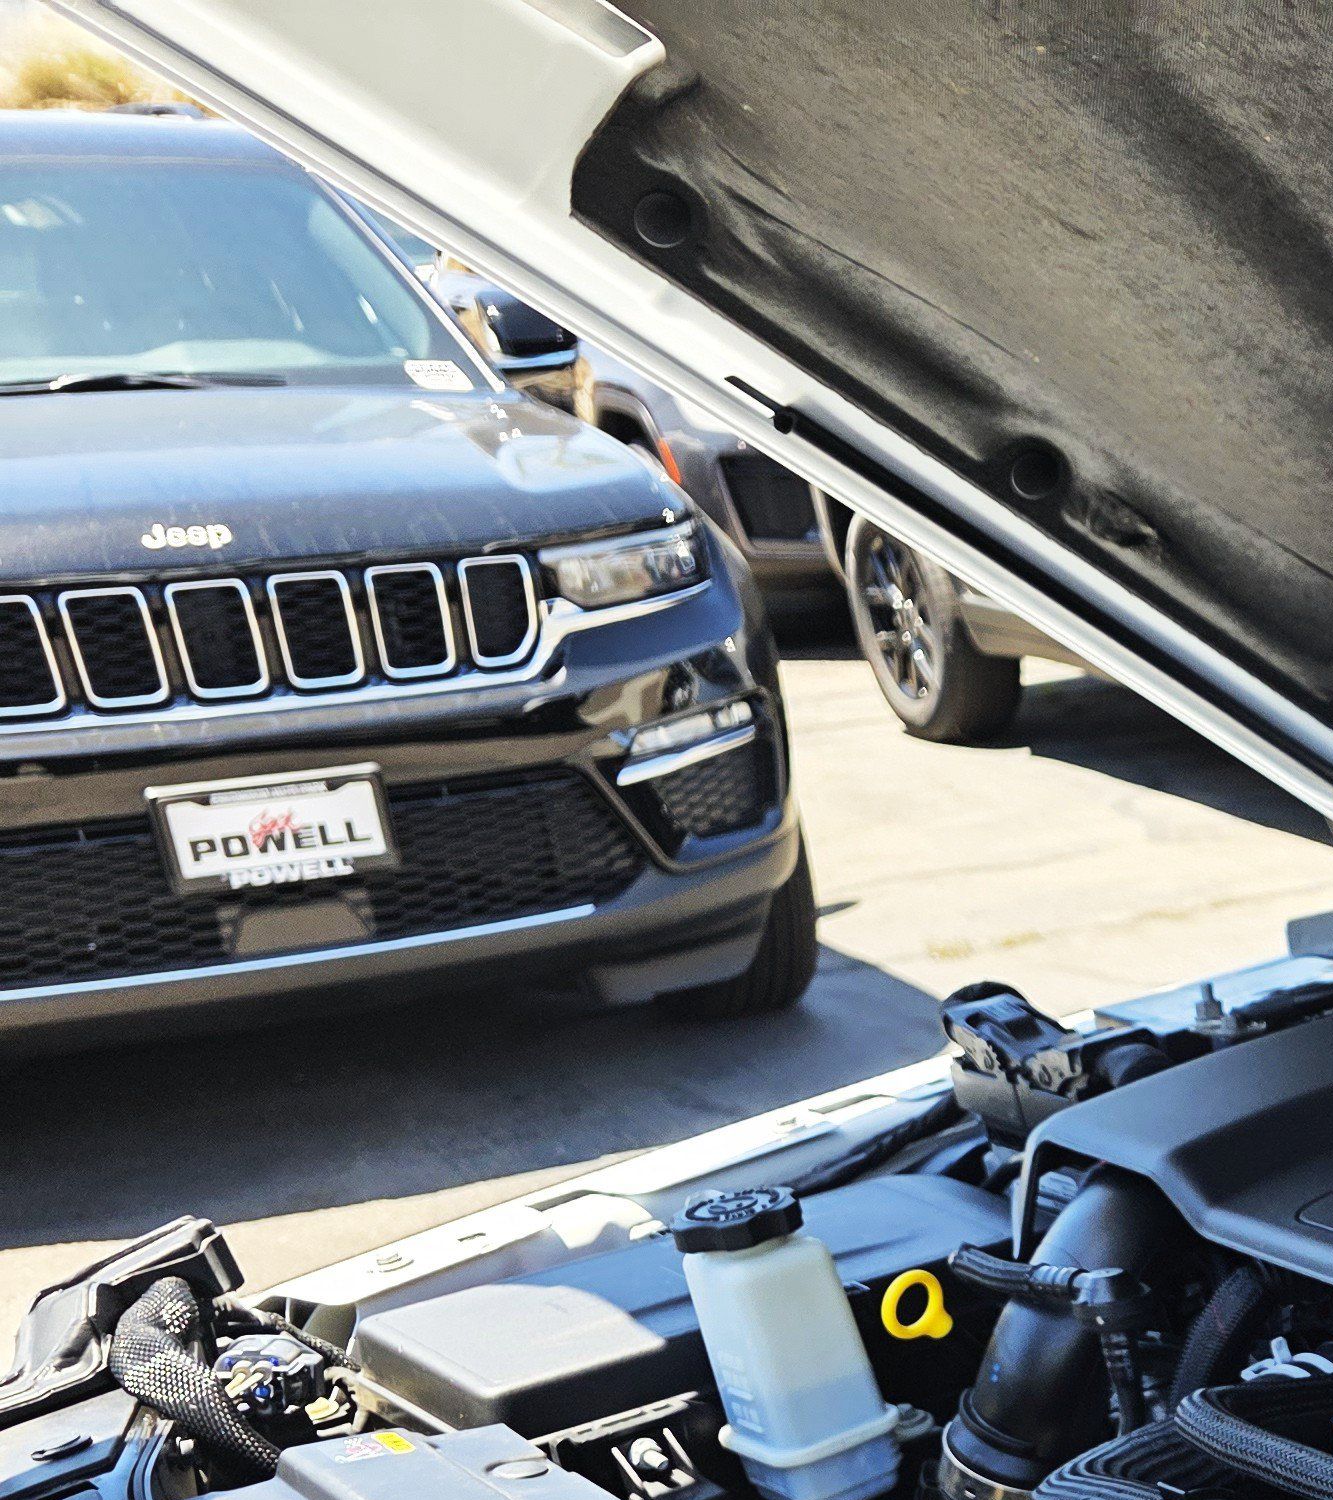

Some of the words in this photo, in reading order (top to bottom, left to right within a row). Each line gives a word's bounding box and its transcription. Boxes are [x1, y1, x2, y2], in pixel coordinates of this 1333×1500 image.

[141, 521, 233, 550] Jeep
[188, 820, 372, 862] POWELL
[228, 856, 355, 889] POWELL
